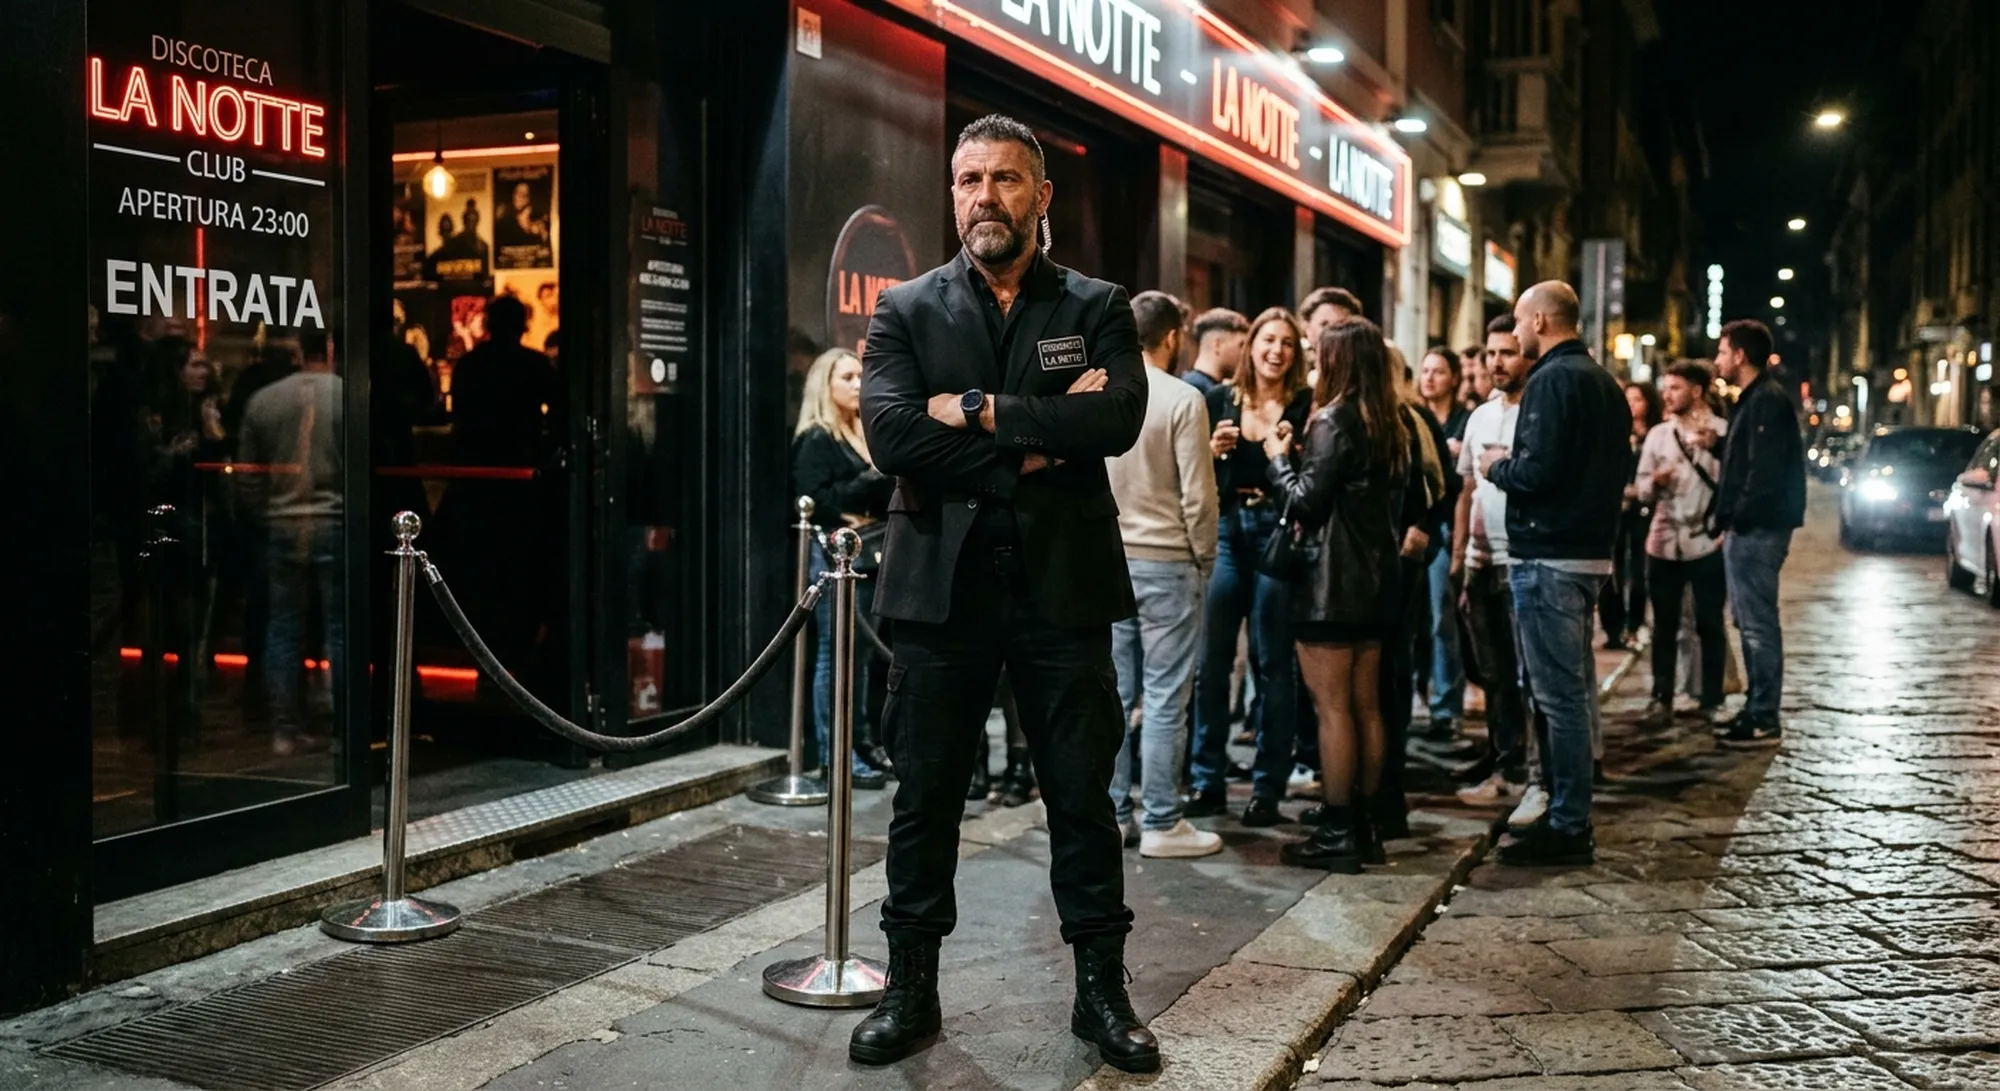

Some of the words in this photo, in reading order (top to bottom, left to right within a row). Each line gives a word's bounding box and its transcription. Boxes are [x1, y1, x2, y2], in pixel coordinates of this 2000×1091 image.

[151, 34, 274, 86] DISCOTECA
[90, 57, 158, 127] LA
[172, 74, 326, 158] NOTTE
[1058, 0, 1161, 96] NOTTE
[1213, 57, 1240, 137] LA
[1241, 76, 1300, 170] NOTTE
[1329, 133, 1350, 199] LA
[1349, 145, 1393, 220] NOTTE
[186, 150, 246, 183] CLUB
[118, 186, 246, 230] APERTURA
[251, 206, 309, 238] 23:00
[106, 258, 325, 329] ENTRATA
[839, 269, 862, 315] LA
